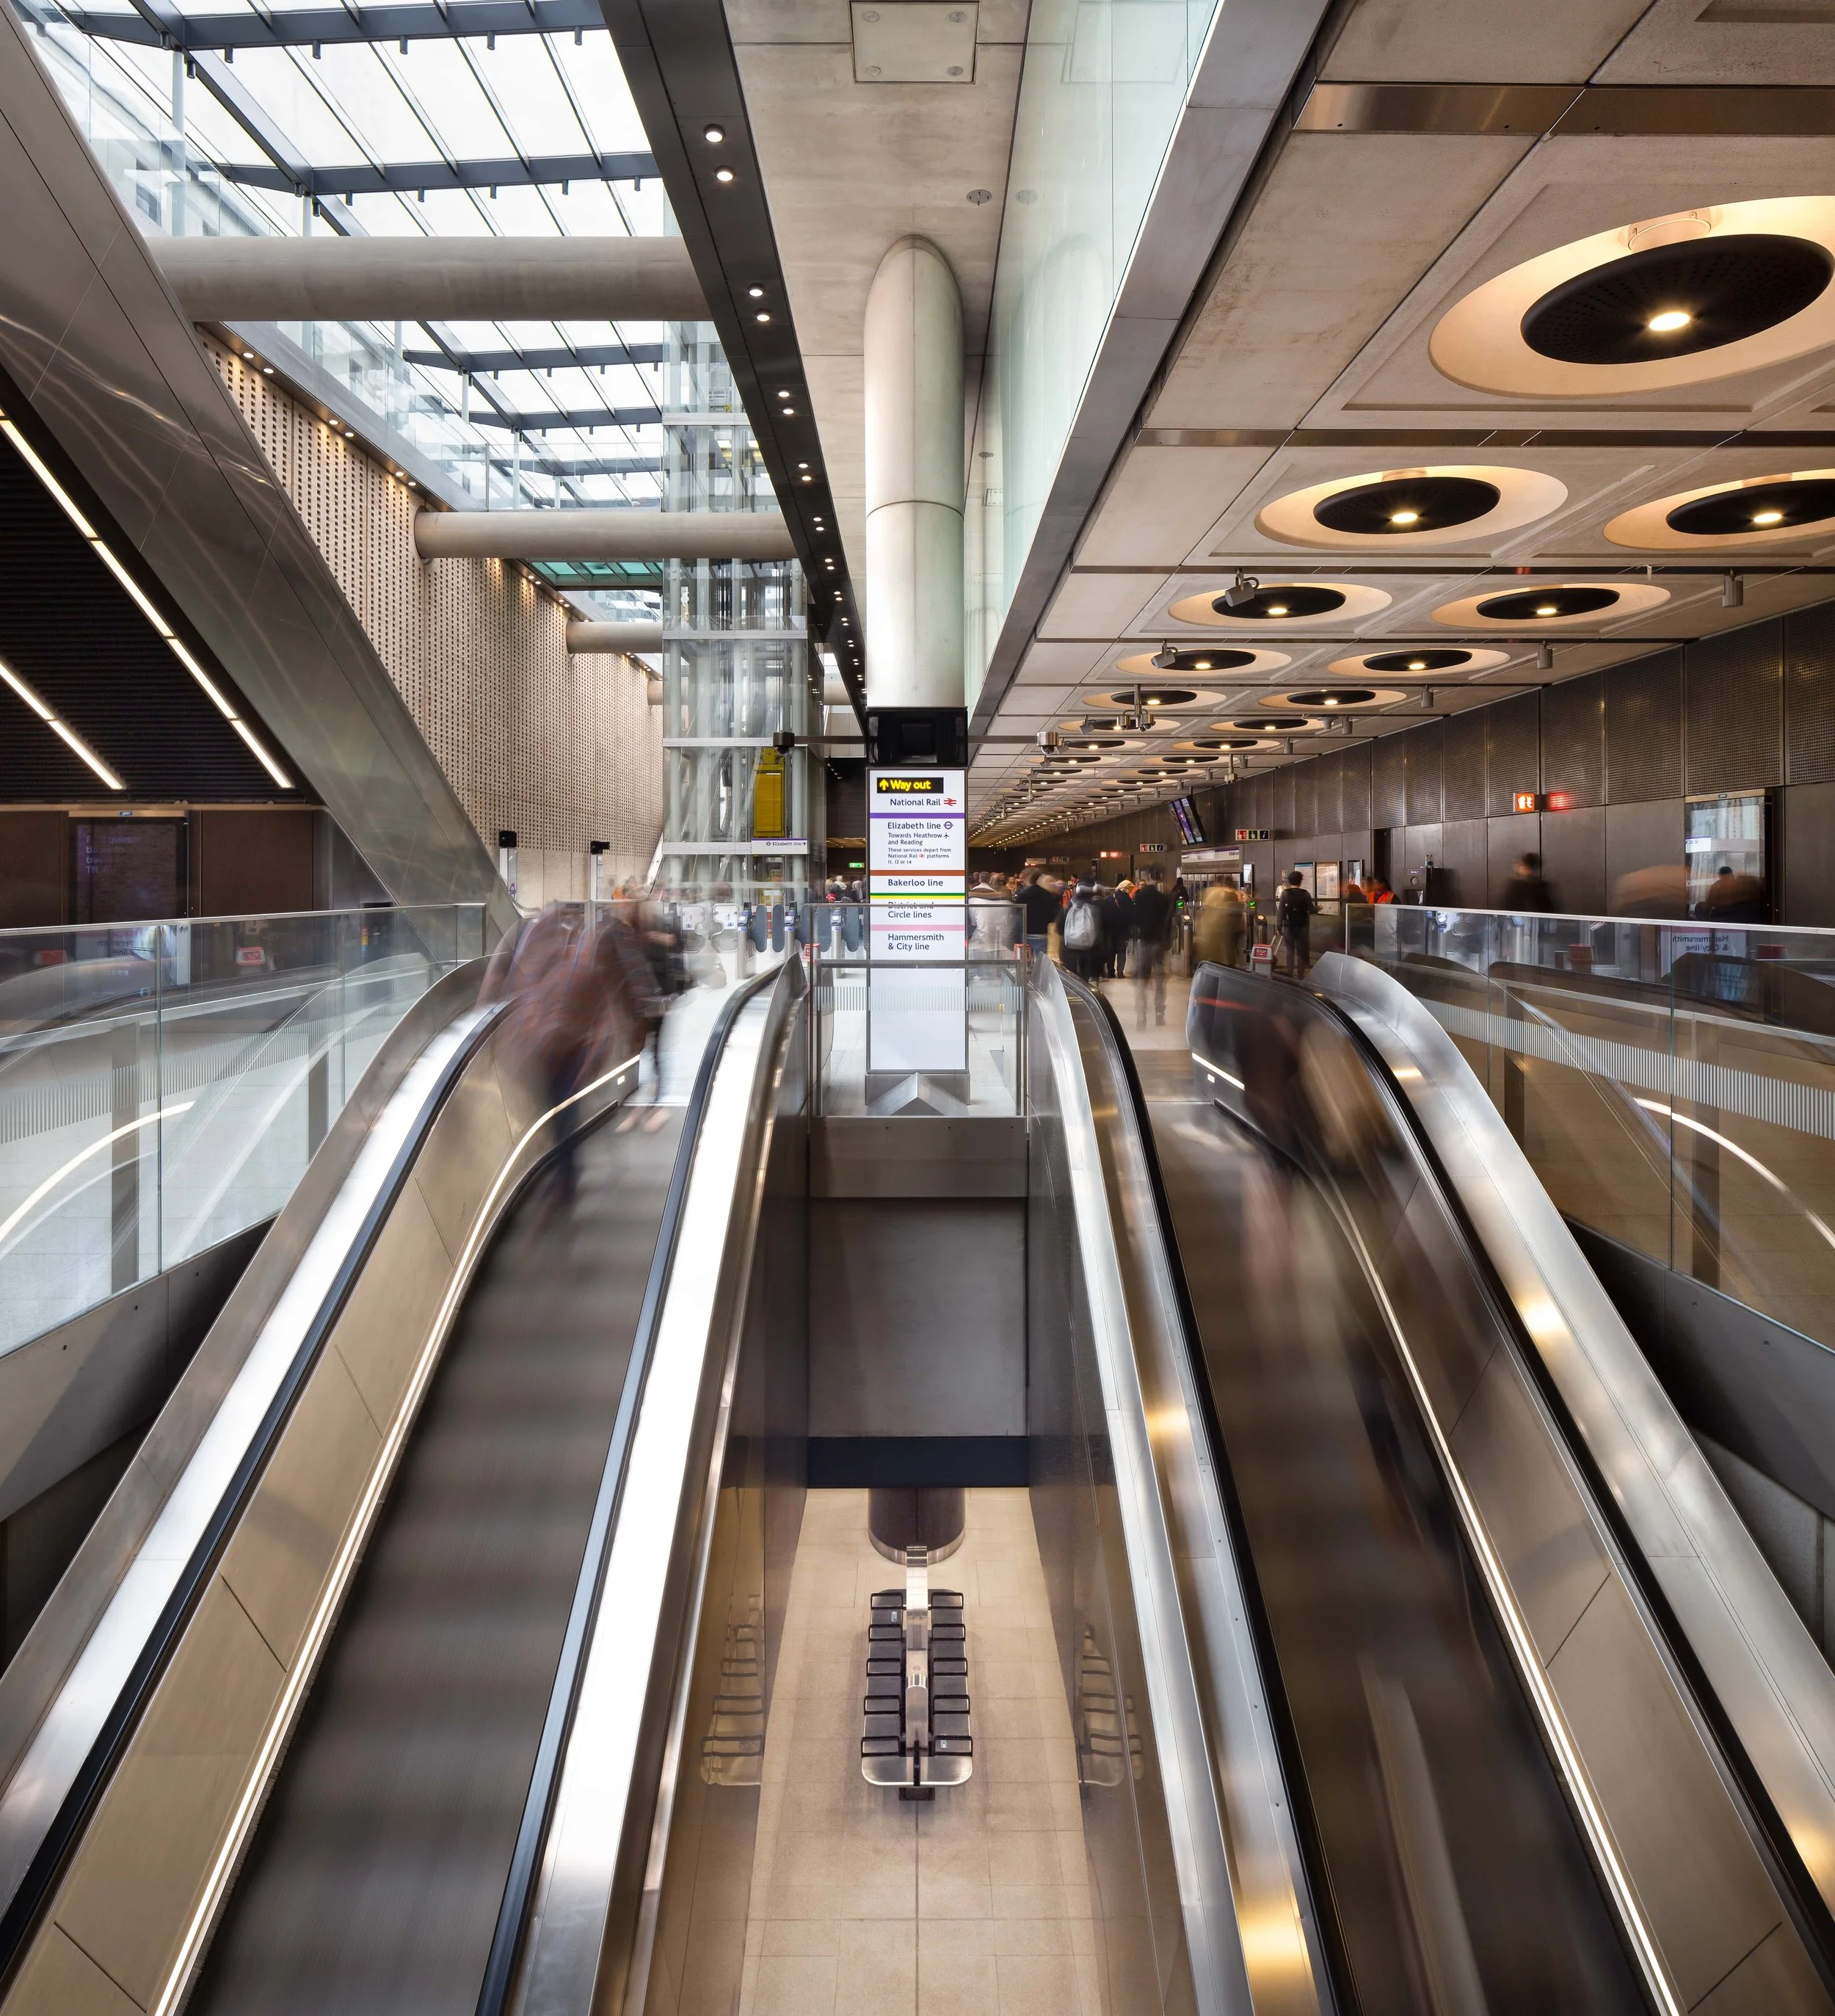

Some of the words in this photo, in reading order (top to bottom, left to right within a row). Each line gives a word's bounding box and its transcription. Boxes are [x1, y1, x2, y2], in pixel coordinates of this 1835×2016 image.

[890, 780, 912, 791] Way
[913, 780, 931, 789] out
[890, 798, 924, 806] National
[926, 798, 941, 806] Rail
[887, 822, 924, 830] Elizabeth
[926, 822, 941, 830] line
[887, 910, 911, 918] Circle
[913, 910, 932, 918] lines
[896, 943, 912, 951] City
